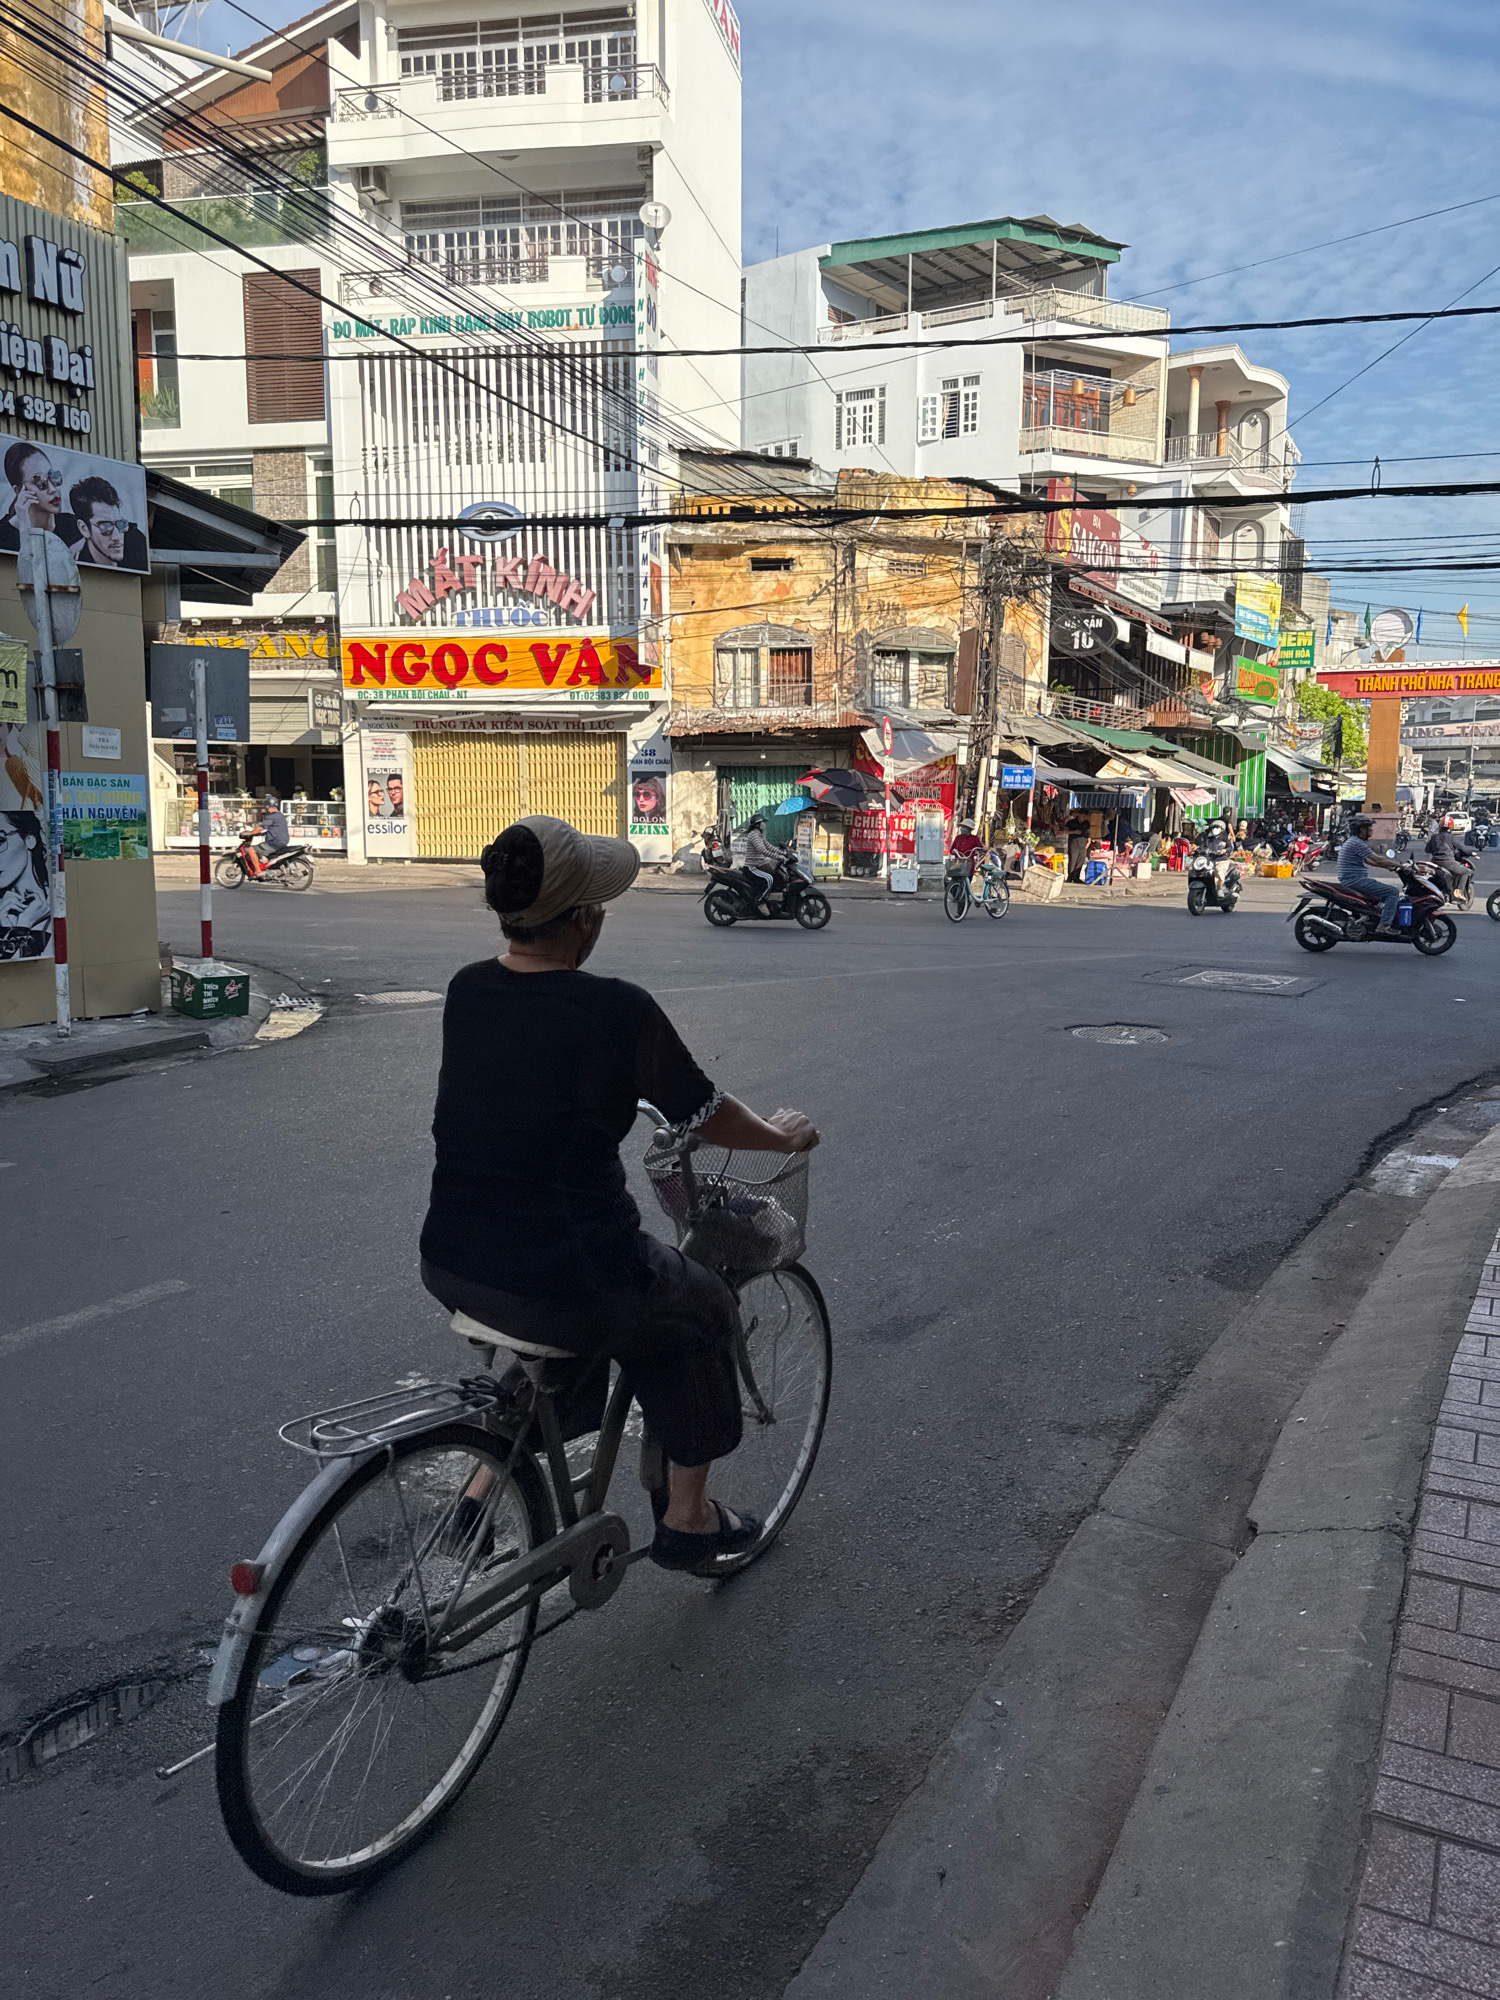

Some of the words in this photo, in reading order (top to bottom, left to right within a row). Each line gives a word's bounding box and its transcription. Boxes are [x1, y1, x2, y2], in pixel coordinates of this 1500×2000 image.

[31, 236, 85, 312] Nữ
[389, 314, 417, 336] RÁP
[527, 309, 573, 328] ROBOT
[576, 304, 596, 329] TỰ
[599, 303, 635, 328] ĐỘNG
[51, 336, 95, 397] Đại
[23, 395, 57, 425] 392
[63, 405, 91, 434] 160
[396, 547, 483, 621] MẮT
[496, 553, 597, 620] KÍNH
[451, 601, 549, 627] THUỐC
[348, 643, 509, 690] NGỌC
[529, 638, 652, 686] VÂN
[1358, 674, 1399, 692] THÀNH
[1400, 671, 1429, 691] PHỐ
[1428, 674, 1455, 690] NHA
[1459, 672, 1500, 689] TRANG
[373, 690, 384, 699] 38
[427, 688, 450, 699] CHÂU
[456, 690, 468, 699] NT
[413, 720, 457, 729] TRUNG
[460, 719, 487, 730] TÂM
[491, 717, 524, 730] KIỂM
[528, 719, 560, 730] SOÁT
[588, 720, 615, 732] LỰC
[641, 748, 656, 757] 38
[87, 777, 107, 789] ĐẶC
[62, 805, 83, 819] HÁI
[88, 805, 137, 820] NGUYÊN
[367, 821, 407, 834] essilor
[630, 825, 669, 835] ZEISS
